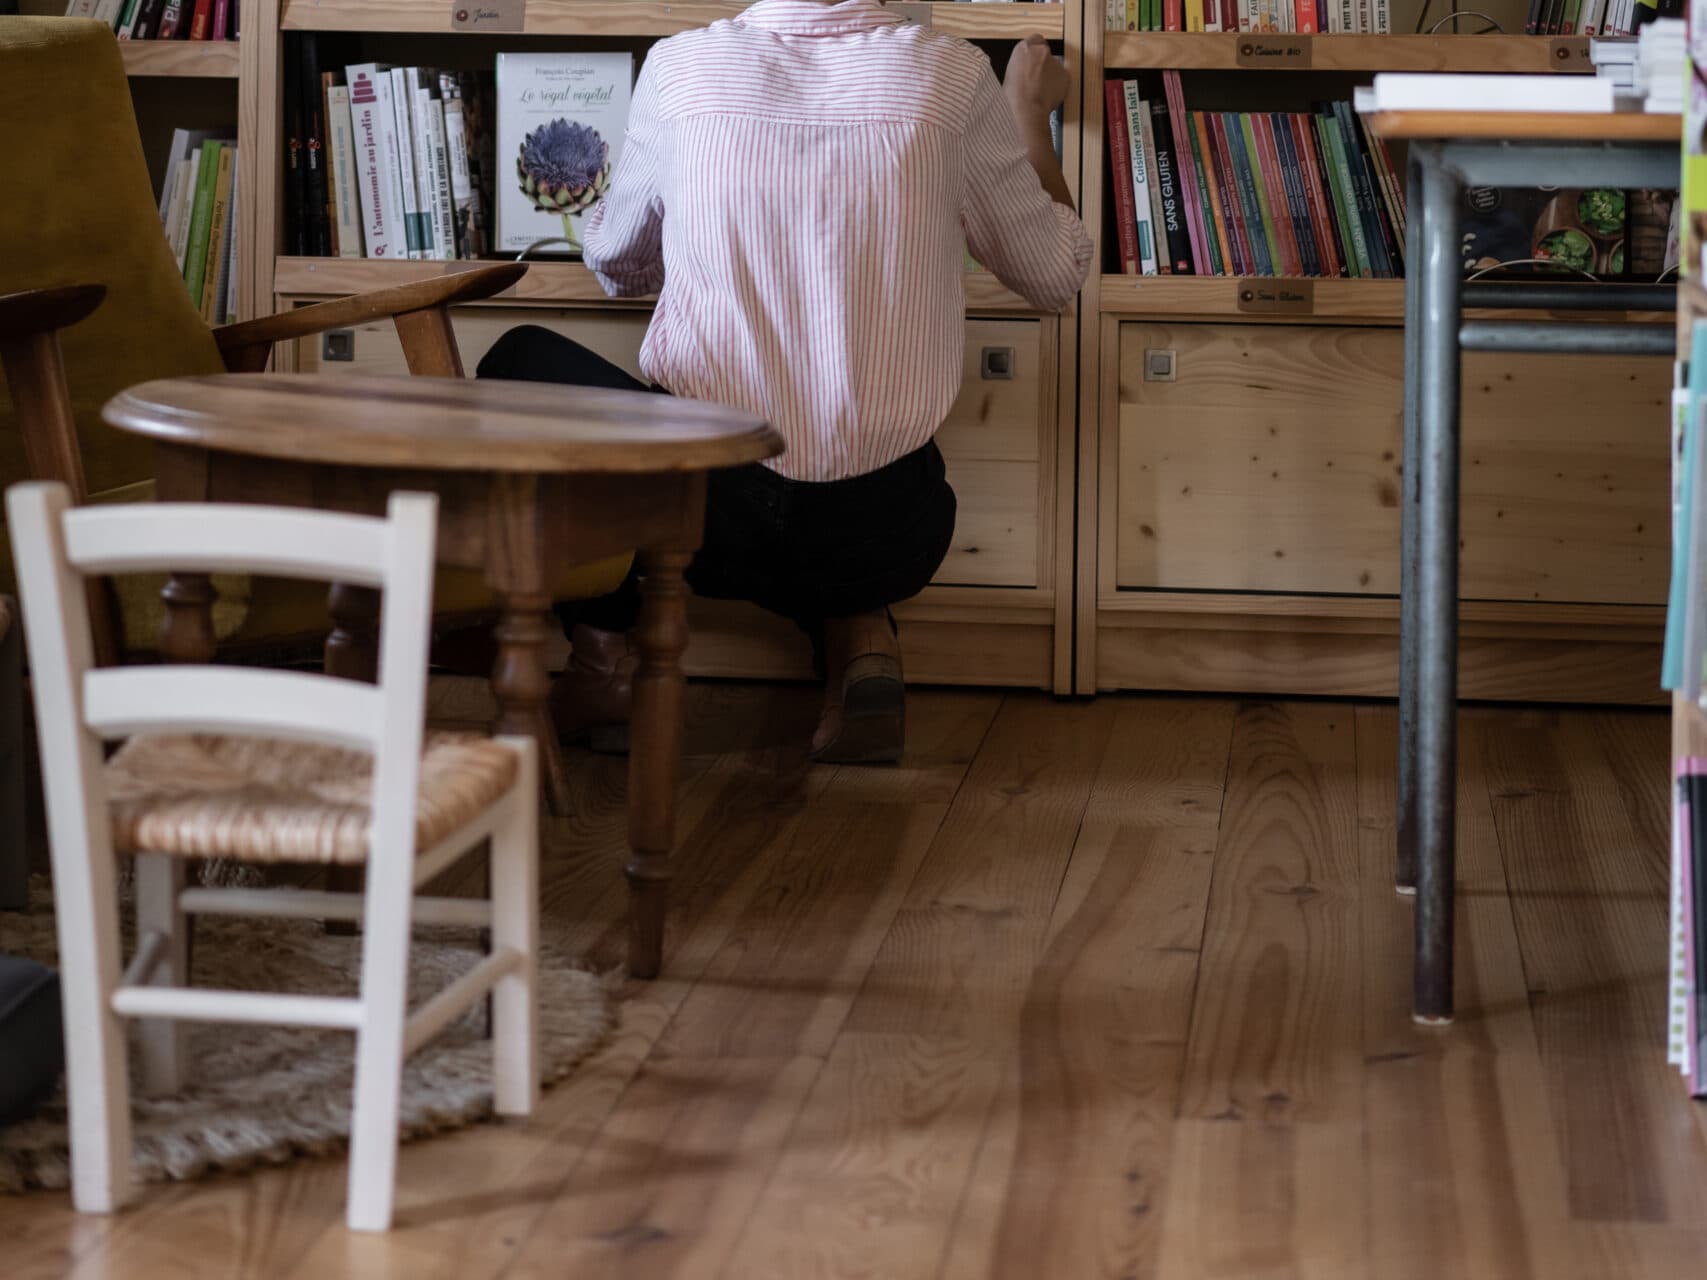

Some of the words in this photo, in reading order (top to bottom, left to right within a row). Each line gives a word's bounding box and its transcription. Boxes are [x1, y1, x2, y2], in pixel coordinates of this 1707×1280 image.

[1342, 10, 1351, 30] PETIT
[520, 90, 534, 104] Le
[541, 85, 569, 105] régal
[573, 84, 614, 104] végétal
[1126, 92, 1138, 110] lait
[362, 110, 376, 148] jardin
[1130, 113, 1141, 136] sans
[367, 149, 375, 163] au
[1133, 138, 1146, 184] Cuisiner
[1158, 151, 1174, 197] GLUTEN
[366, 165, 384, 236] L'autonomie
[1164, 199, 1179, 231] SANS
